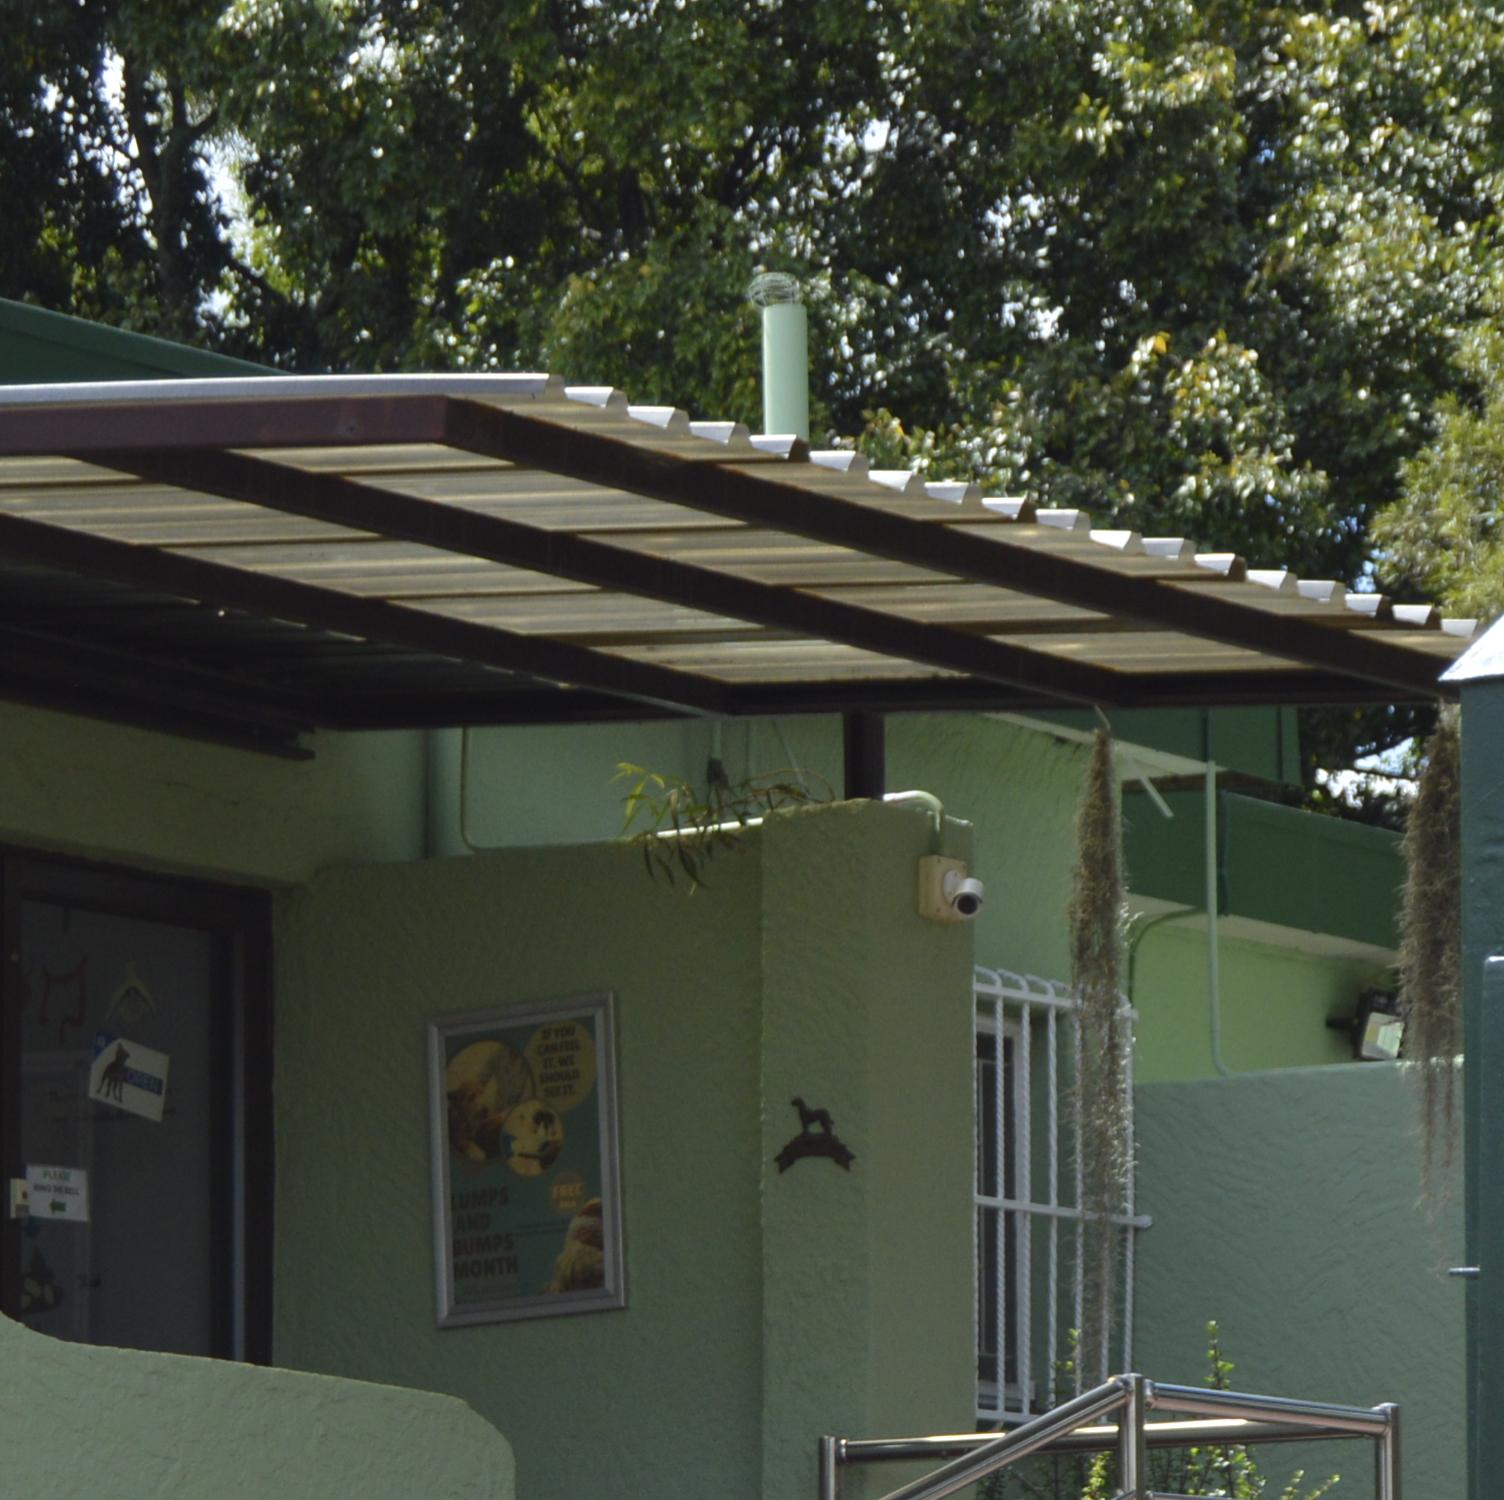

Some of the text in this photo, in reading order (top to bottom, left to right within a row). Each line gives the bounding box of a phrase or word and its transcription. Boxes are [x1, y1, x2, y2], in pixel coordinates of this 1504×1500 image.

[456, 1213, 491, 1232] AND
[453, 1233, 514, 1257] BUMPS
[454, 1256, 518, 1279] MONTH
